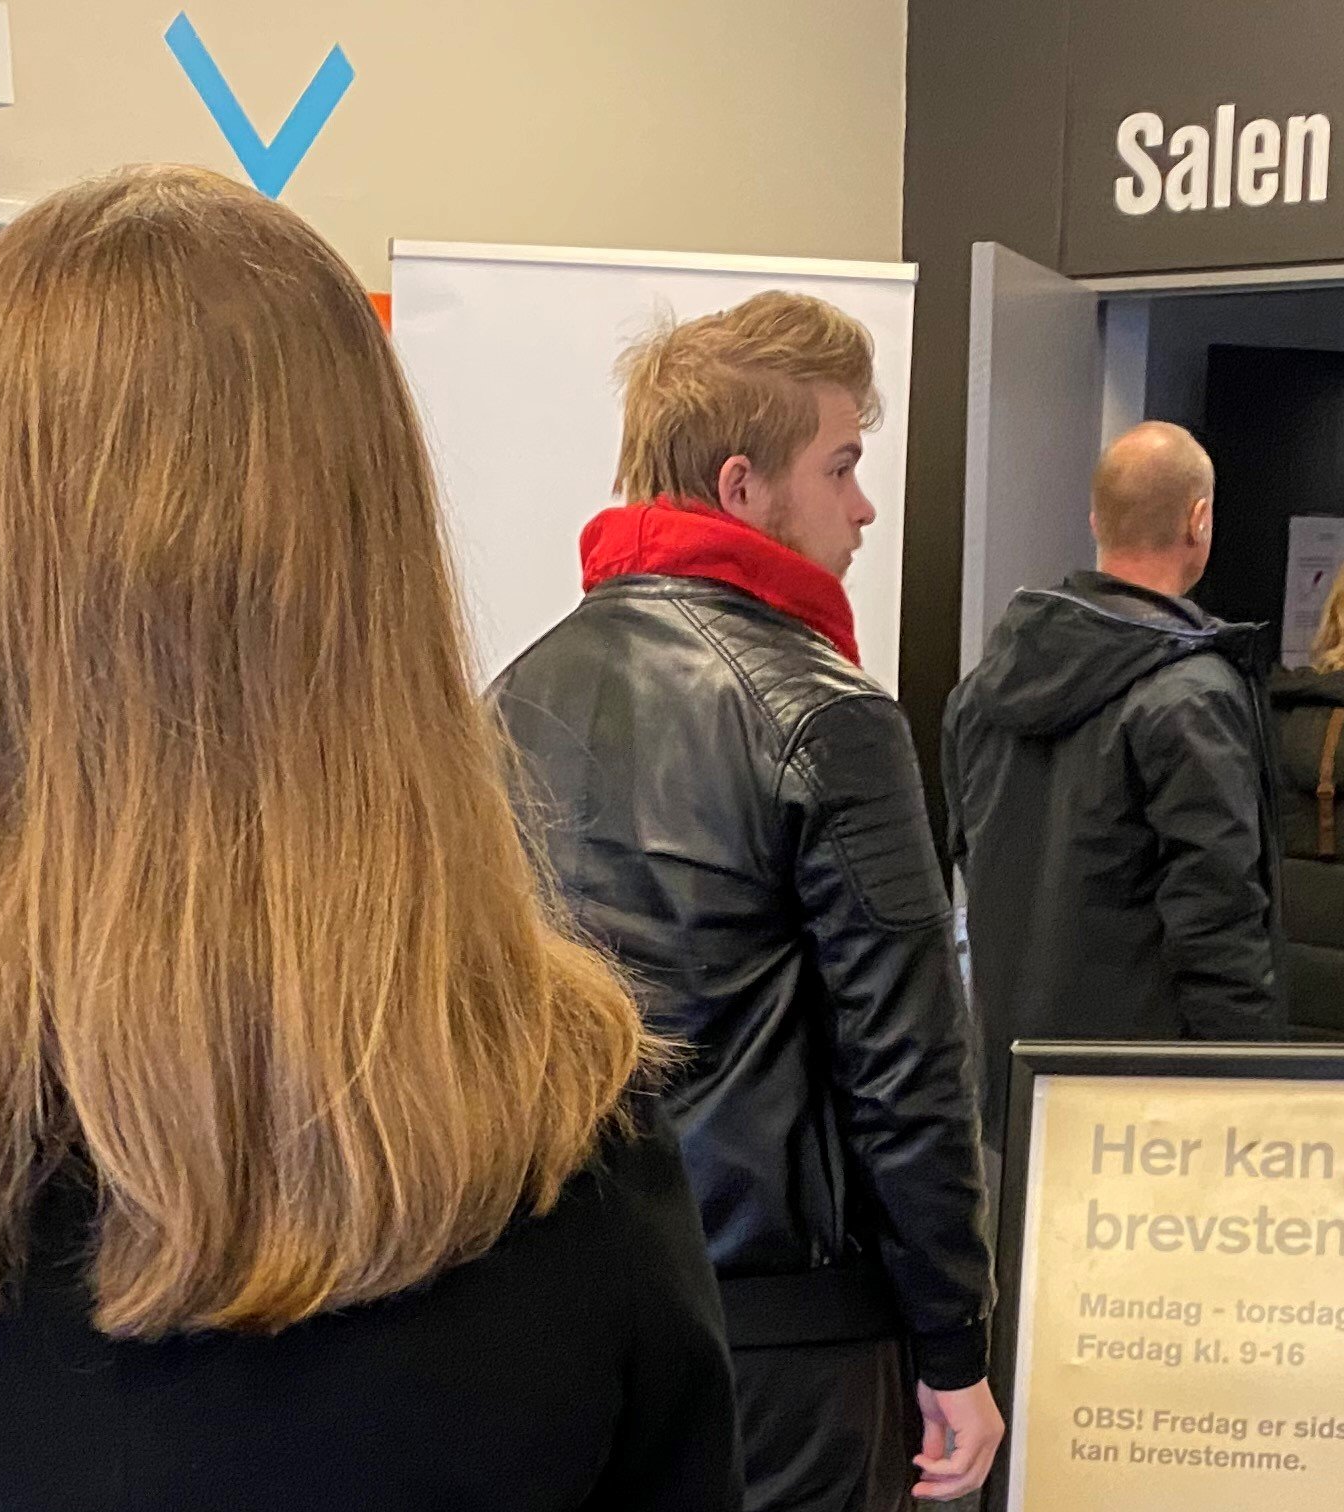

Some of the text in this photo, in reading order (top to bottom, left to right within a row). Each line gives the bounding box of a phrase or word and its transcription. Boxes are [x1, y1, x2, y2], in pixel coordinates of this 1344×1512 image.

[1114, 103, 1331, 216] Salen
[1091, 1123, 1202, 1176] Her
[1224, 1127, 1335, 1179] kan
[1079, 1293, 1202, 1327] Mandag
[1077, 1334, 1306, 1367] Fredag kl. 9-16
[1073, 1406, 1144, 1430] OBS!
[1152, 1410, 1247, 1441] Fredag
[1257, 1419, 1287, 1437] er
[1071, 1439, 1307, 1471] kan brevstemme.
